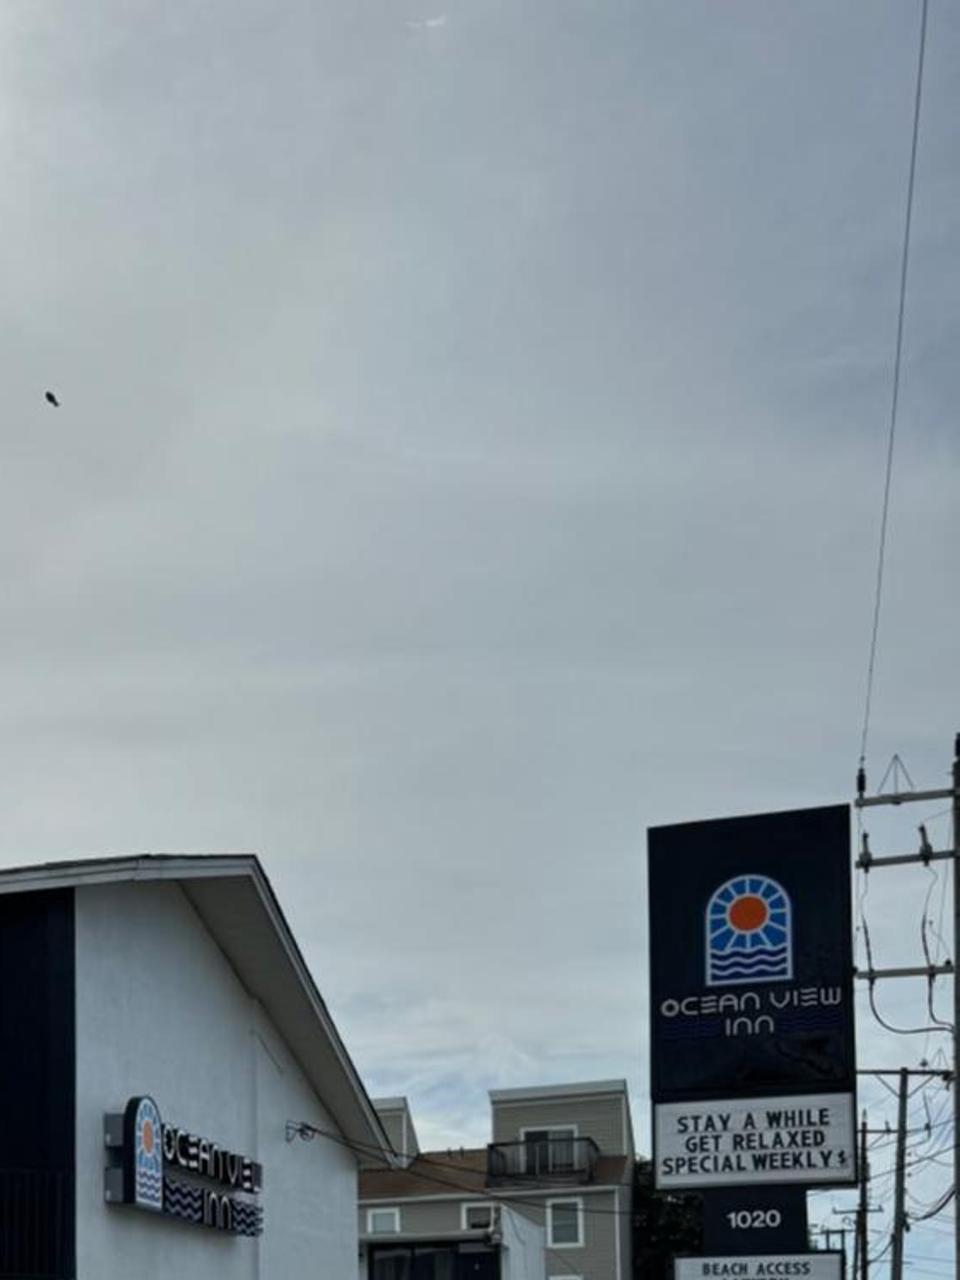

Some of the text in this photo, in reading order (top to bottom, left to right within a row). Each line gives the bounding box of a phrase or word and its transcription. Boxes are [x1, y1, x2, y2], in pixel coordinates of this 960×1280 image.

[661, 987, 841, 1017] OCEAN VIEW
[677, 1108, 830, 1134] STAY A WHILE
[685, 1130, 825, 1154] GET RELAXED
[662, 1155, 747, 1176] SPECIAL
[752, 1150, 833, 1171] WEEKLY
[727, 1209, 781, 1229] 1020
[702, 1262, 811, 1276] BEACH ACCESS
